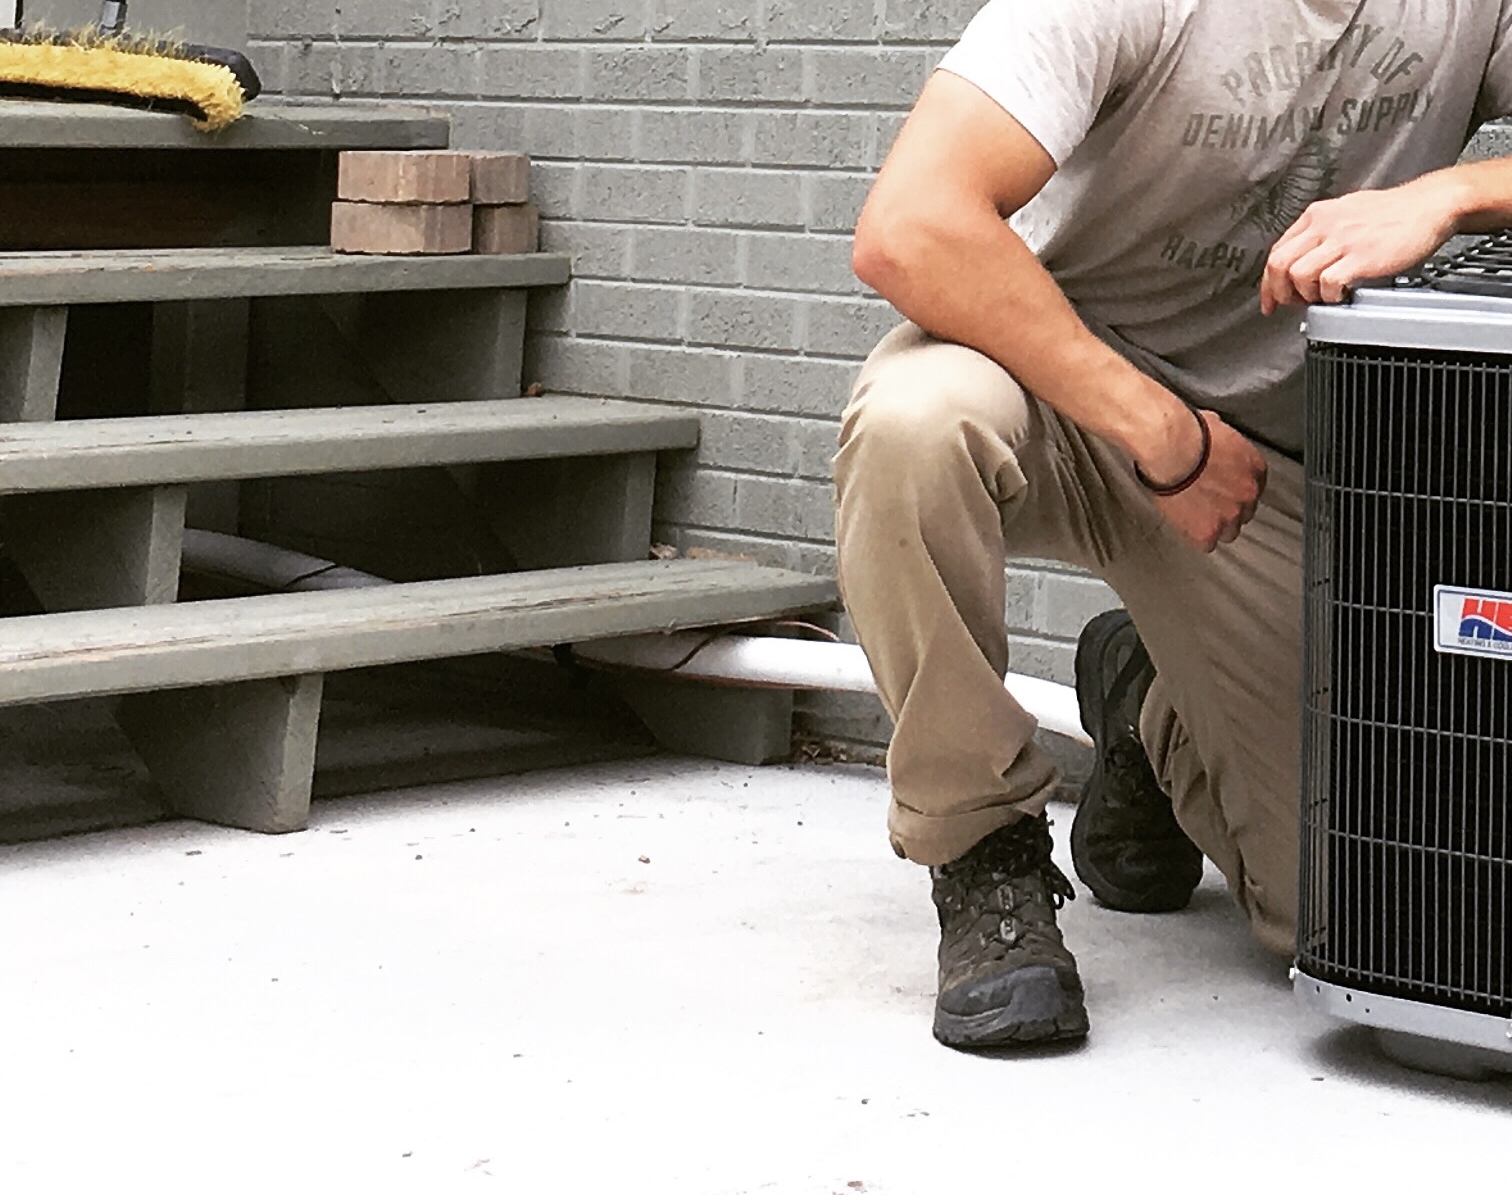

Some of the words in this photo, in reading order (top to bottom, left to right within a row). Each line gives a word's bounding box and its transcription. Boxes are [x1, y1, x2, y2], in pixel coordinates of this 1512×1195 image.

[1221, 24, 1383, 107] PROPETY
[1369, 36, 1424, 85] OF
[1336, 88, 1434, 135] SUPPLY
